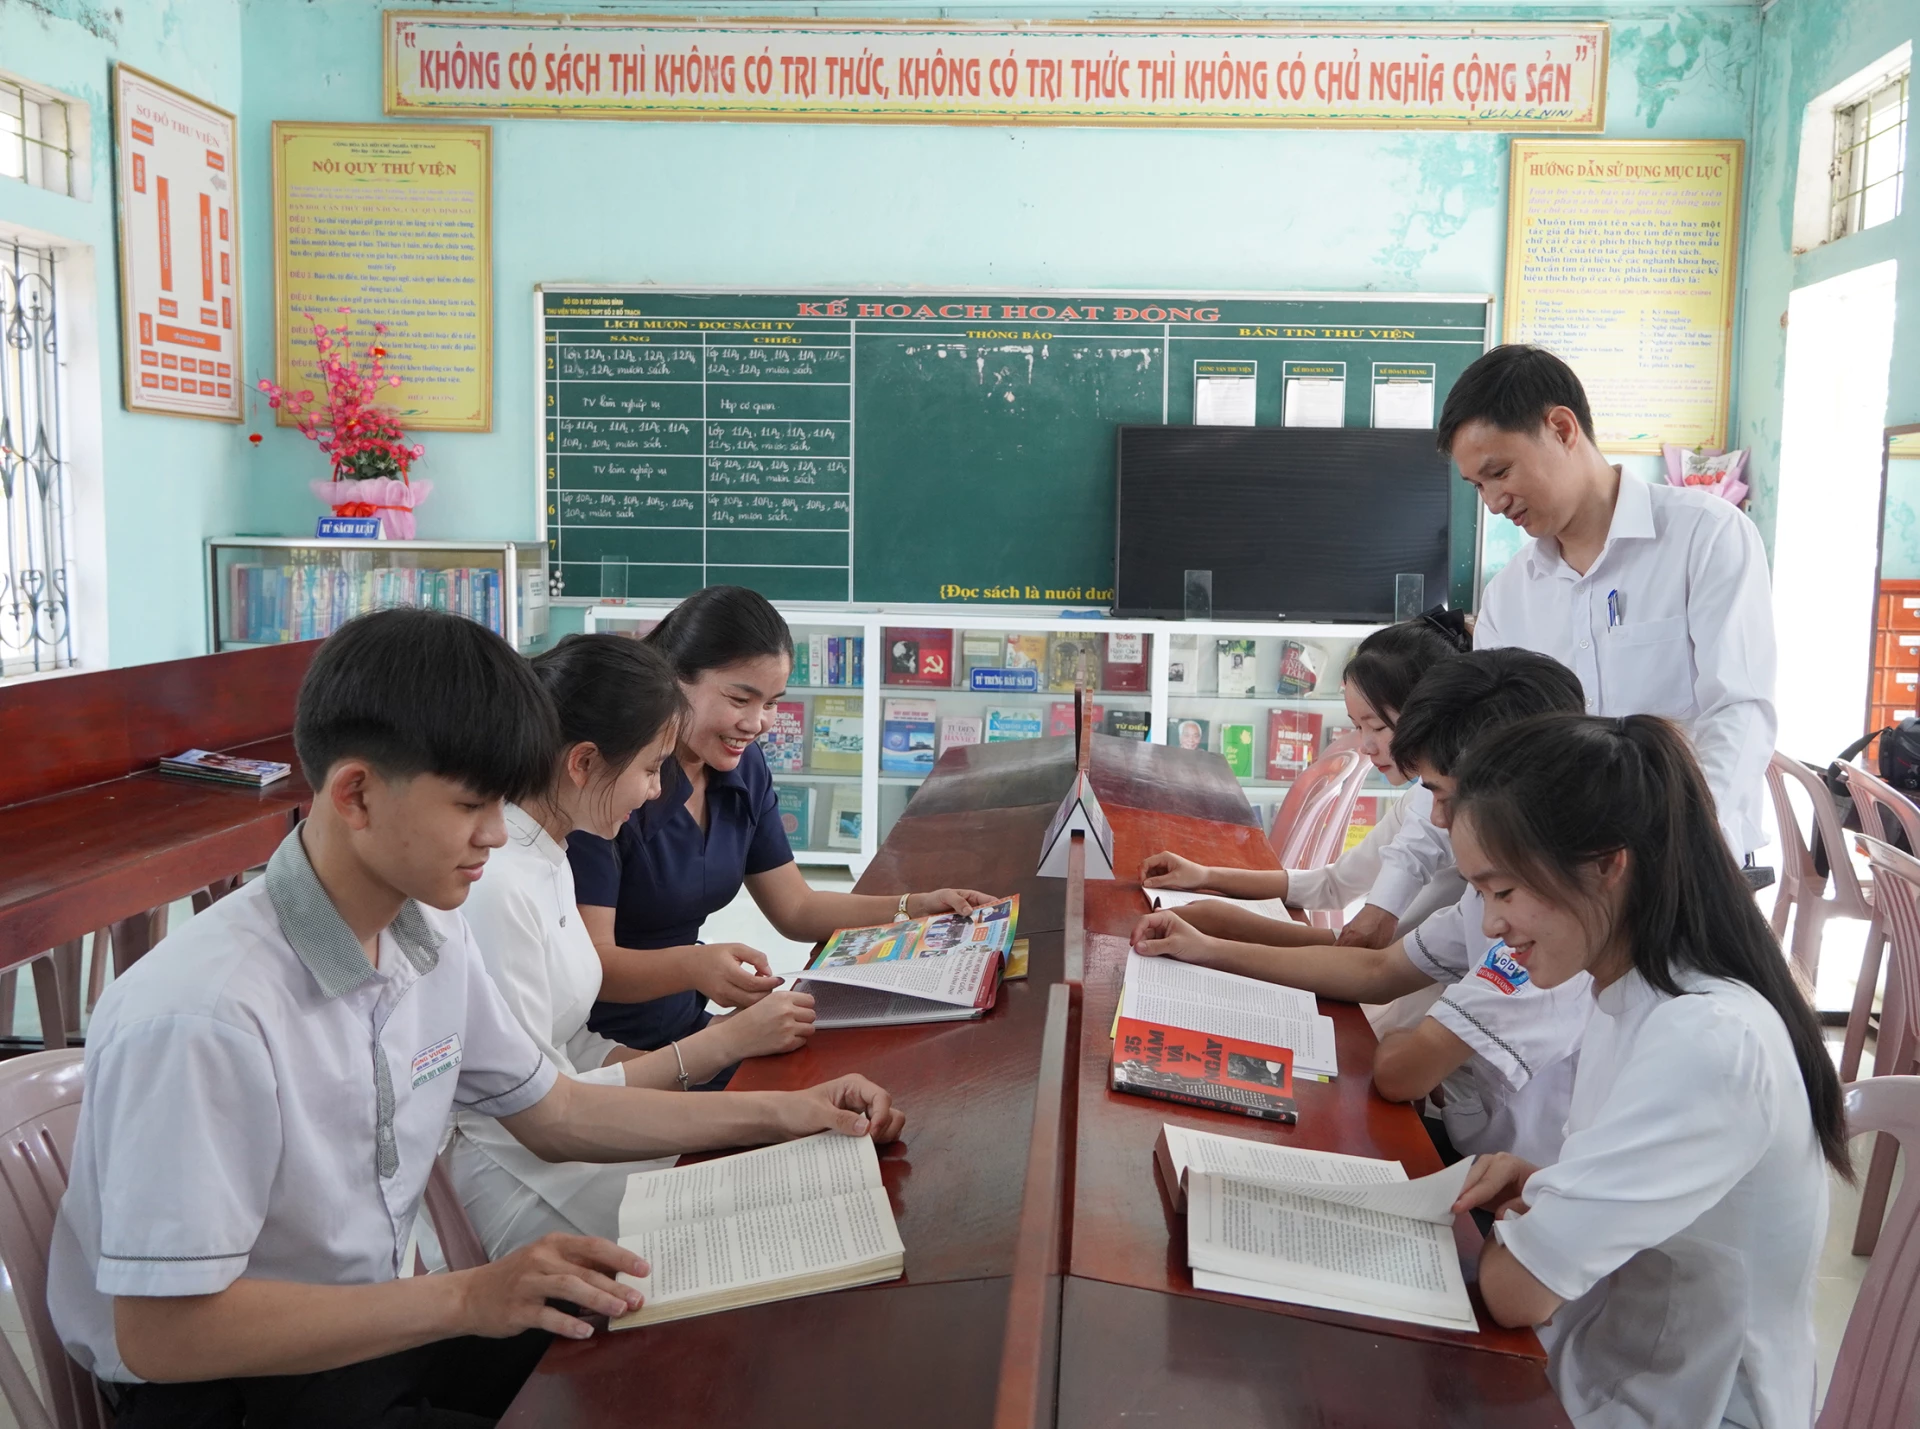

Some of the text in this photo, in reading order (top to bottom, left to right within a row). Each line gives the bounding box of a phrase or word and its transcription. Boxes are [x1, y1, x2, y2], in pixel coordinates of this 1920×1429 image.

[509, 43, 536, 91] CÓ
[546, 44, 599, 94] SÁCH
[609, 45, 645, 94] THÌ
[656, 46, 734, 94] KHÔNG
[744, 47, 772, 95] CÓ
[781, 57, 816, 97] TRI
[826, 48, 888, 98] THỨC,
[899, 49, 980, 98] KHÔNG
[990, 50, 1017, 98] CÓ
[1026, 60, 1062, 101] TRI
[1072, 50, 1129, 101] THỨC
[1138, 51, 1175, 101] THÌ
[1185, 51, 1266, 101] KHÔNG
[1277, 52, 1305, 101] CÓ
[1315, 49, 1359, 103] CHỦ
[1370, 54, 1444, 103] NGHĨA
[1454, 54, 1515, 110] CỘNG
[312, 158, 457, 177] NỘI QUY THƯ VIỆN
[1529, 159, 1723, 181] HƯỚNG DẪN SỬ DỤNG MỤC LỤC
[797, 298, 1221, 323] KẾ HOẠCH HOẠT ĐỘNG
[604, 320, 795, 331] LỊCH MƯỢN ĐỌC SÁCH TV
[610, 334, 650, 342] SÁNG
[966, 329, 1053, 340] THÔNG BÁO
[1239, 326, 1415, 340] BẢN TIN THƯ VIỆN
[753, 336, 802, 344] CHIỀU
[547, 358, 554, 369] 2
[547, 395, 554, 406] 3
[547, 431, 554, 442] 4
[548, 468, 555, 479] 5
[548, 504, 555, 515] 6
[322, 521, 375, 536] TỦ SÁCH LUẬT
[549, 539, 556, 550] 7
[983, 585, 1020, 599] sách
[1025, 586, 1040, 599] là
[1045, 587, 1081, 600] nuôi
[1500, 958, 1507, 966] G
[1508, 963, 1516, 971] D
[1125, 1035, 1143, 1056] 35
[1144, 1029, 1164, 1067] NĂM
[1164, 1044, 1184, 1063] VÀ
[1186, 1052, 1202, 1063] 7
[1202, 1037, 1223, 1082] NGÀY
